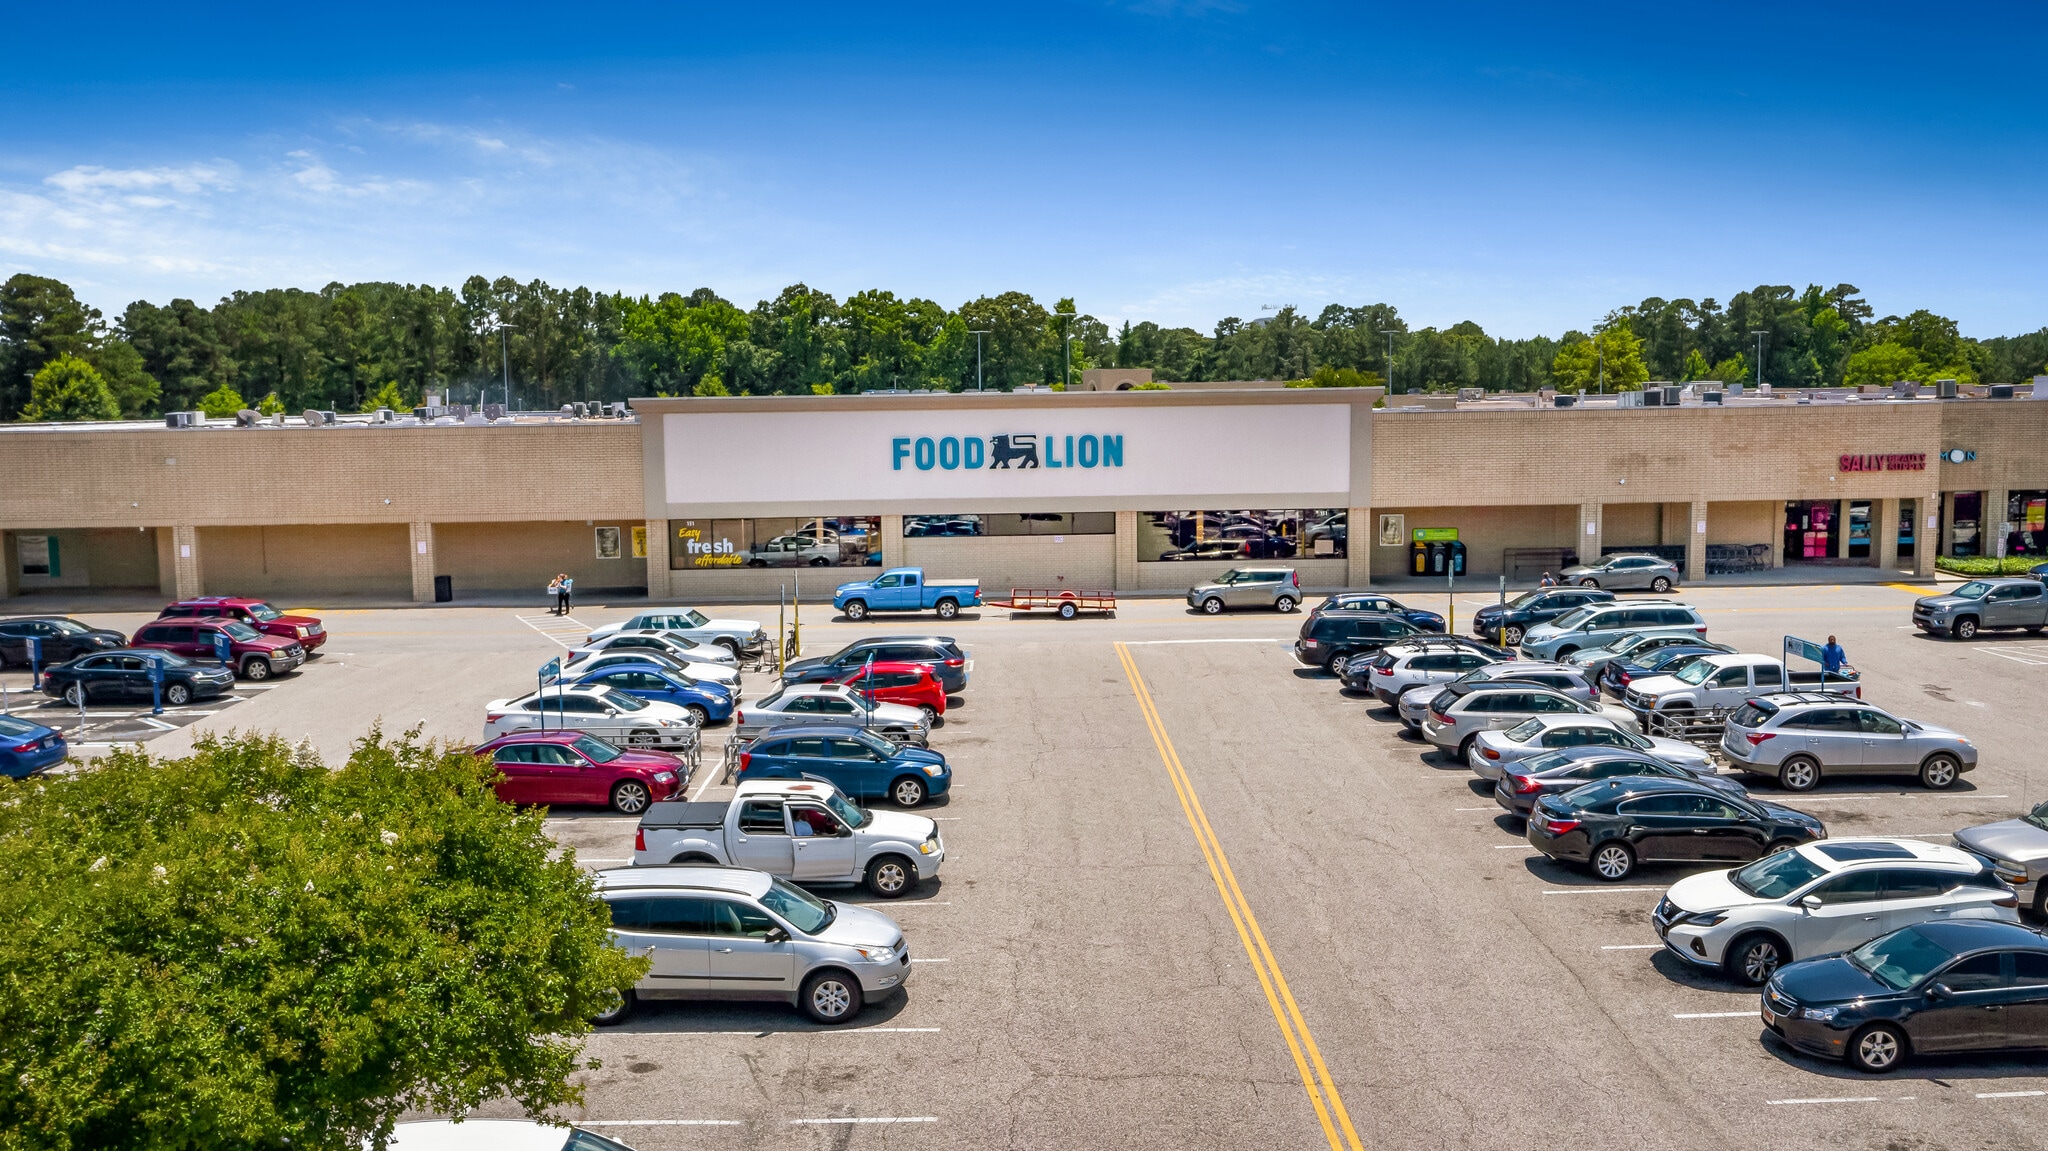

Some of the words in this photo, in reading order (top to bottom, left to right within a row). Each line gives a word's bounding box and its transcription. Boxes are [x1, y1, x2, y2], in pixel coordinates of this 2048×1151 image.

[892, 436, 985, 471] FOOD
[1045, 434, 1123, 469] LION
[1886, 453, 1926, 463] BEAUTY
[1840, 455, 1885, 471] SALLY
[1886, 462, 1926, 471] SUPPLY
[679, 528, 701, 541] Easy
[687, 538, 734, 554] fresh
[695, 554, 742, 566] affordable
